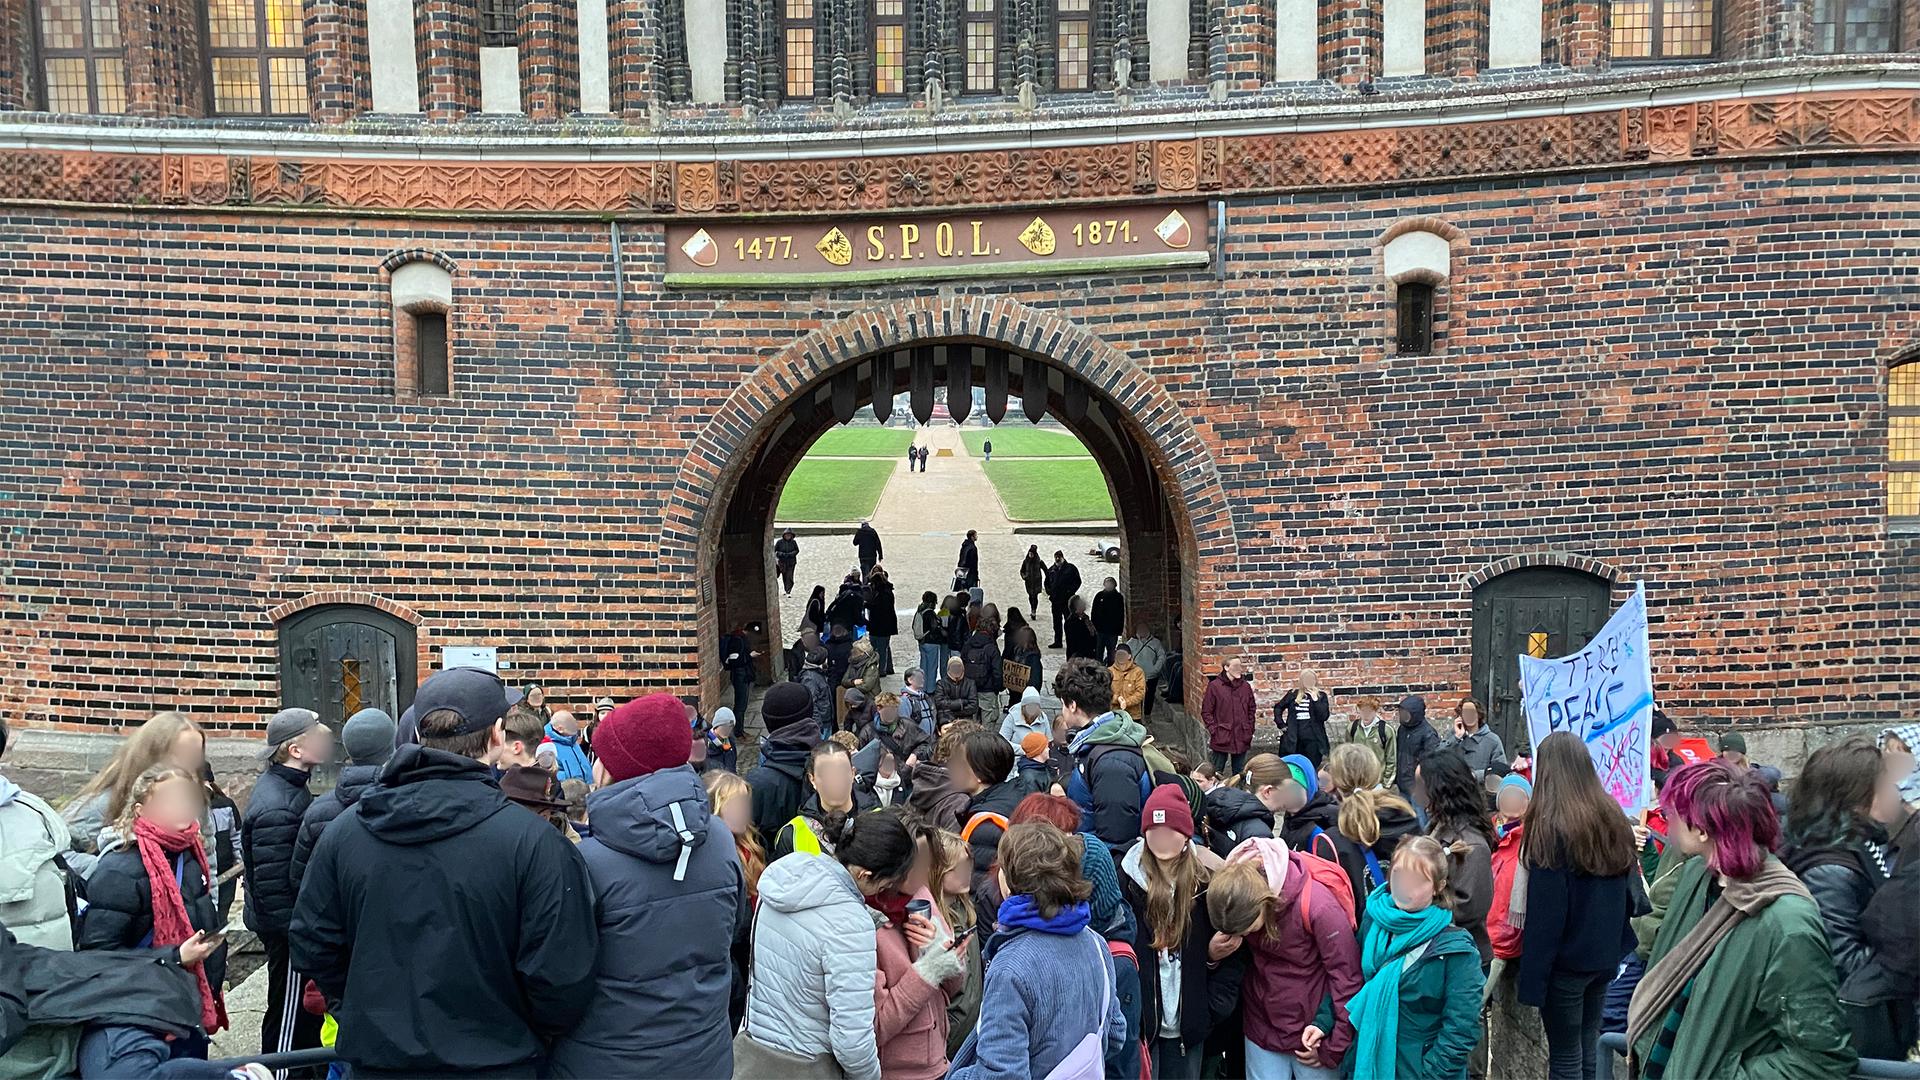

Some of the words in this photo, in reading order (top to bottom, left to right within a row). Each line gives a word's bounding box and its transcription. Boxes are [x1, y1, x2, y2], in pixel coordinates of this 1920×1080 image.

[734, 235, 799, 260] 1477.
[1072, 219, 1139, 246] 1871.
[1547, 676, 1627, 741] PEACE
